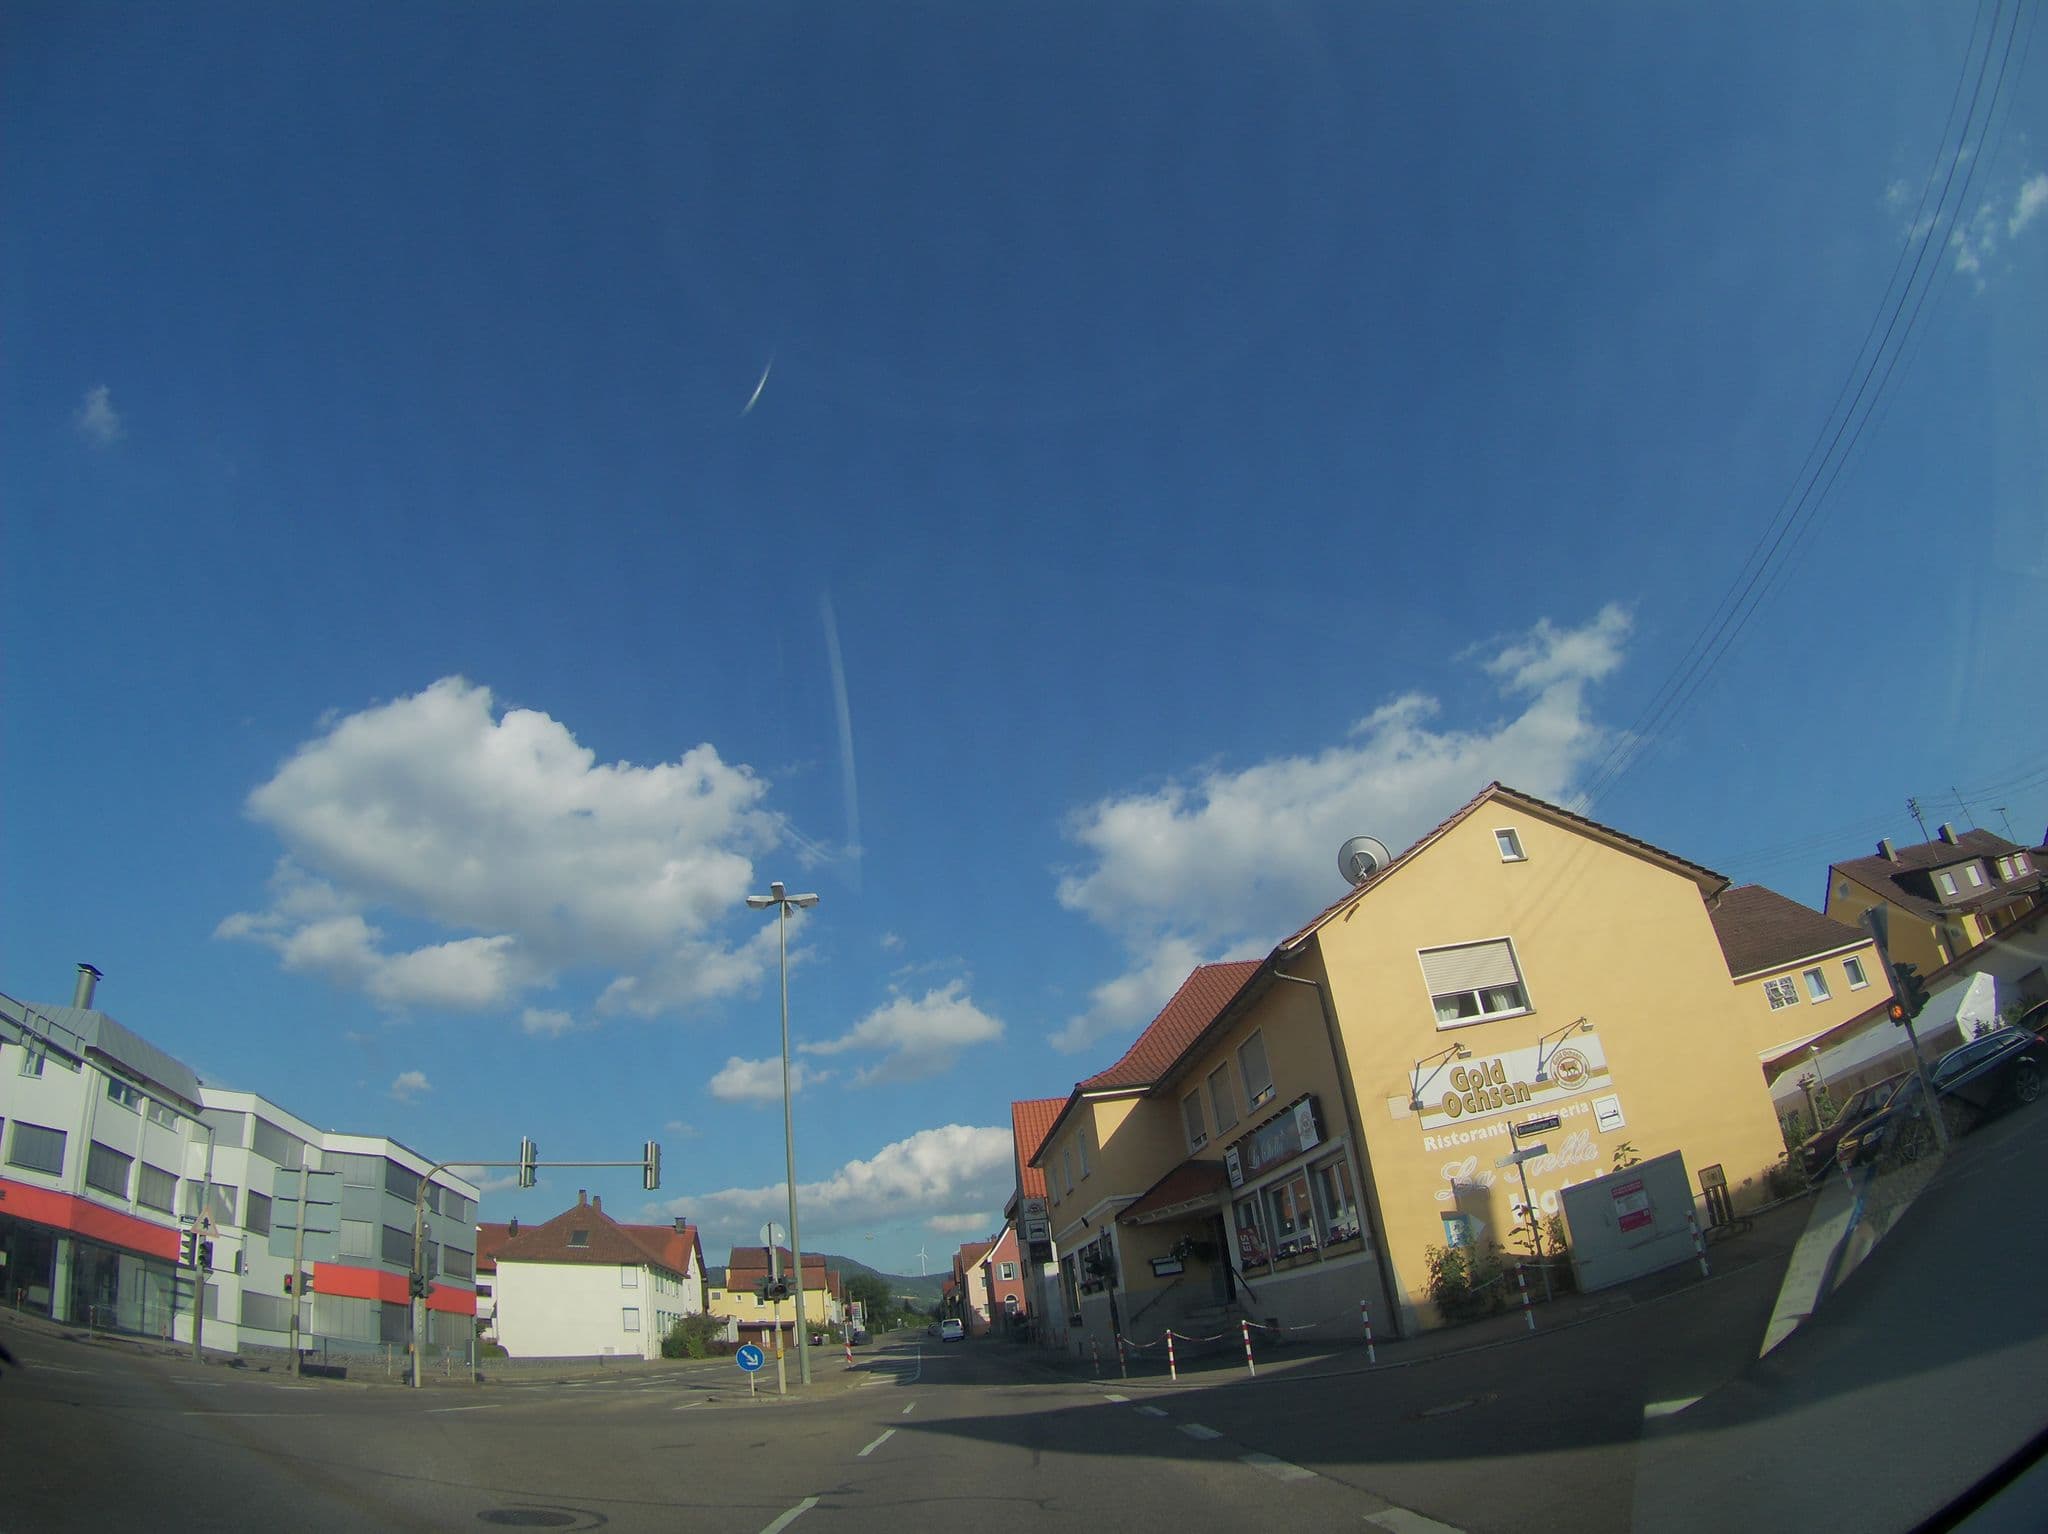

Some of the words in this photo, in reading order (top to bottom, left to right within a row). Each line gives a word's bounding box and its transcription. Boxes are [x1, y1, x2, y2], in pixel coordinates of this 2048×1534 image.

[1449, 1058, 1507, 1092] Gold
[1441, 1081, 1531, 1118] Ochsen
[1527, 1102, 1589, 1122] Peria
